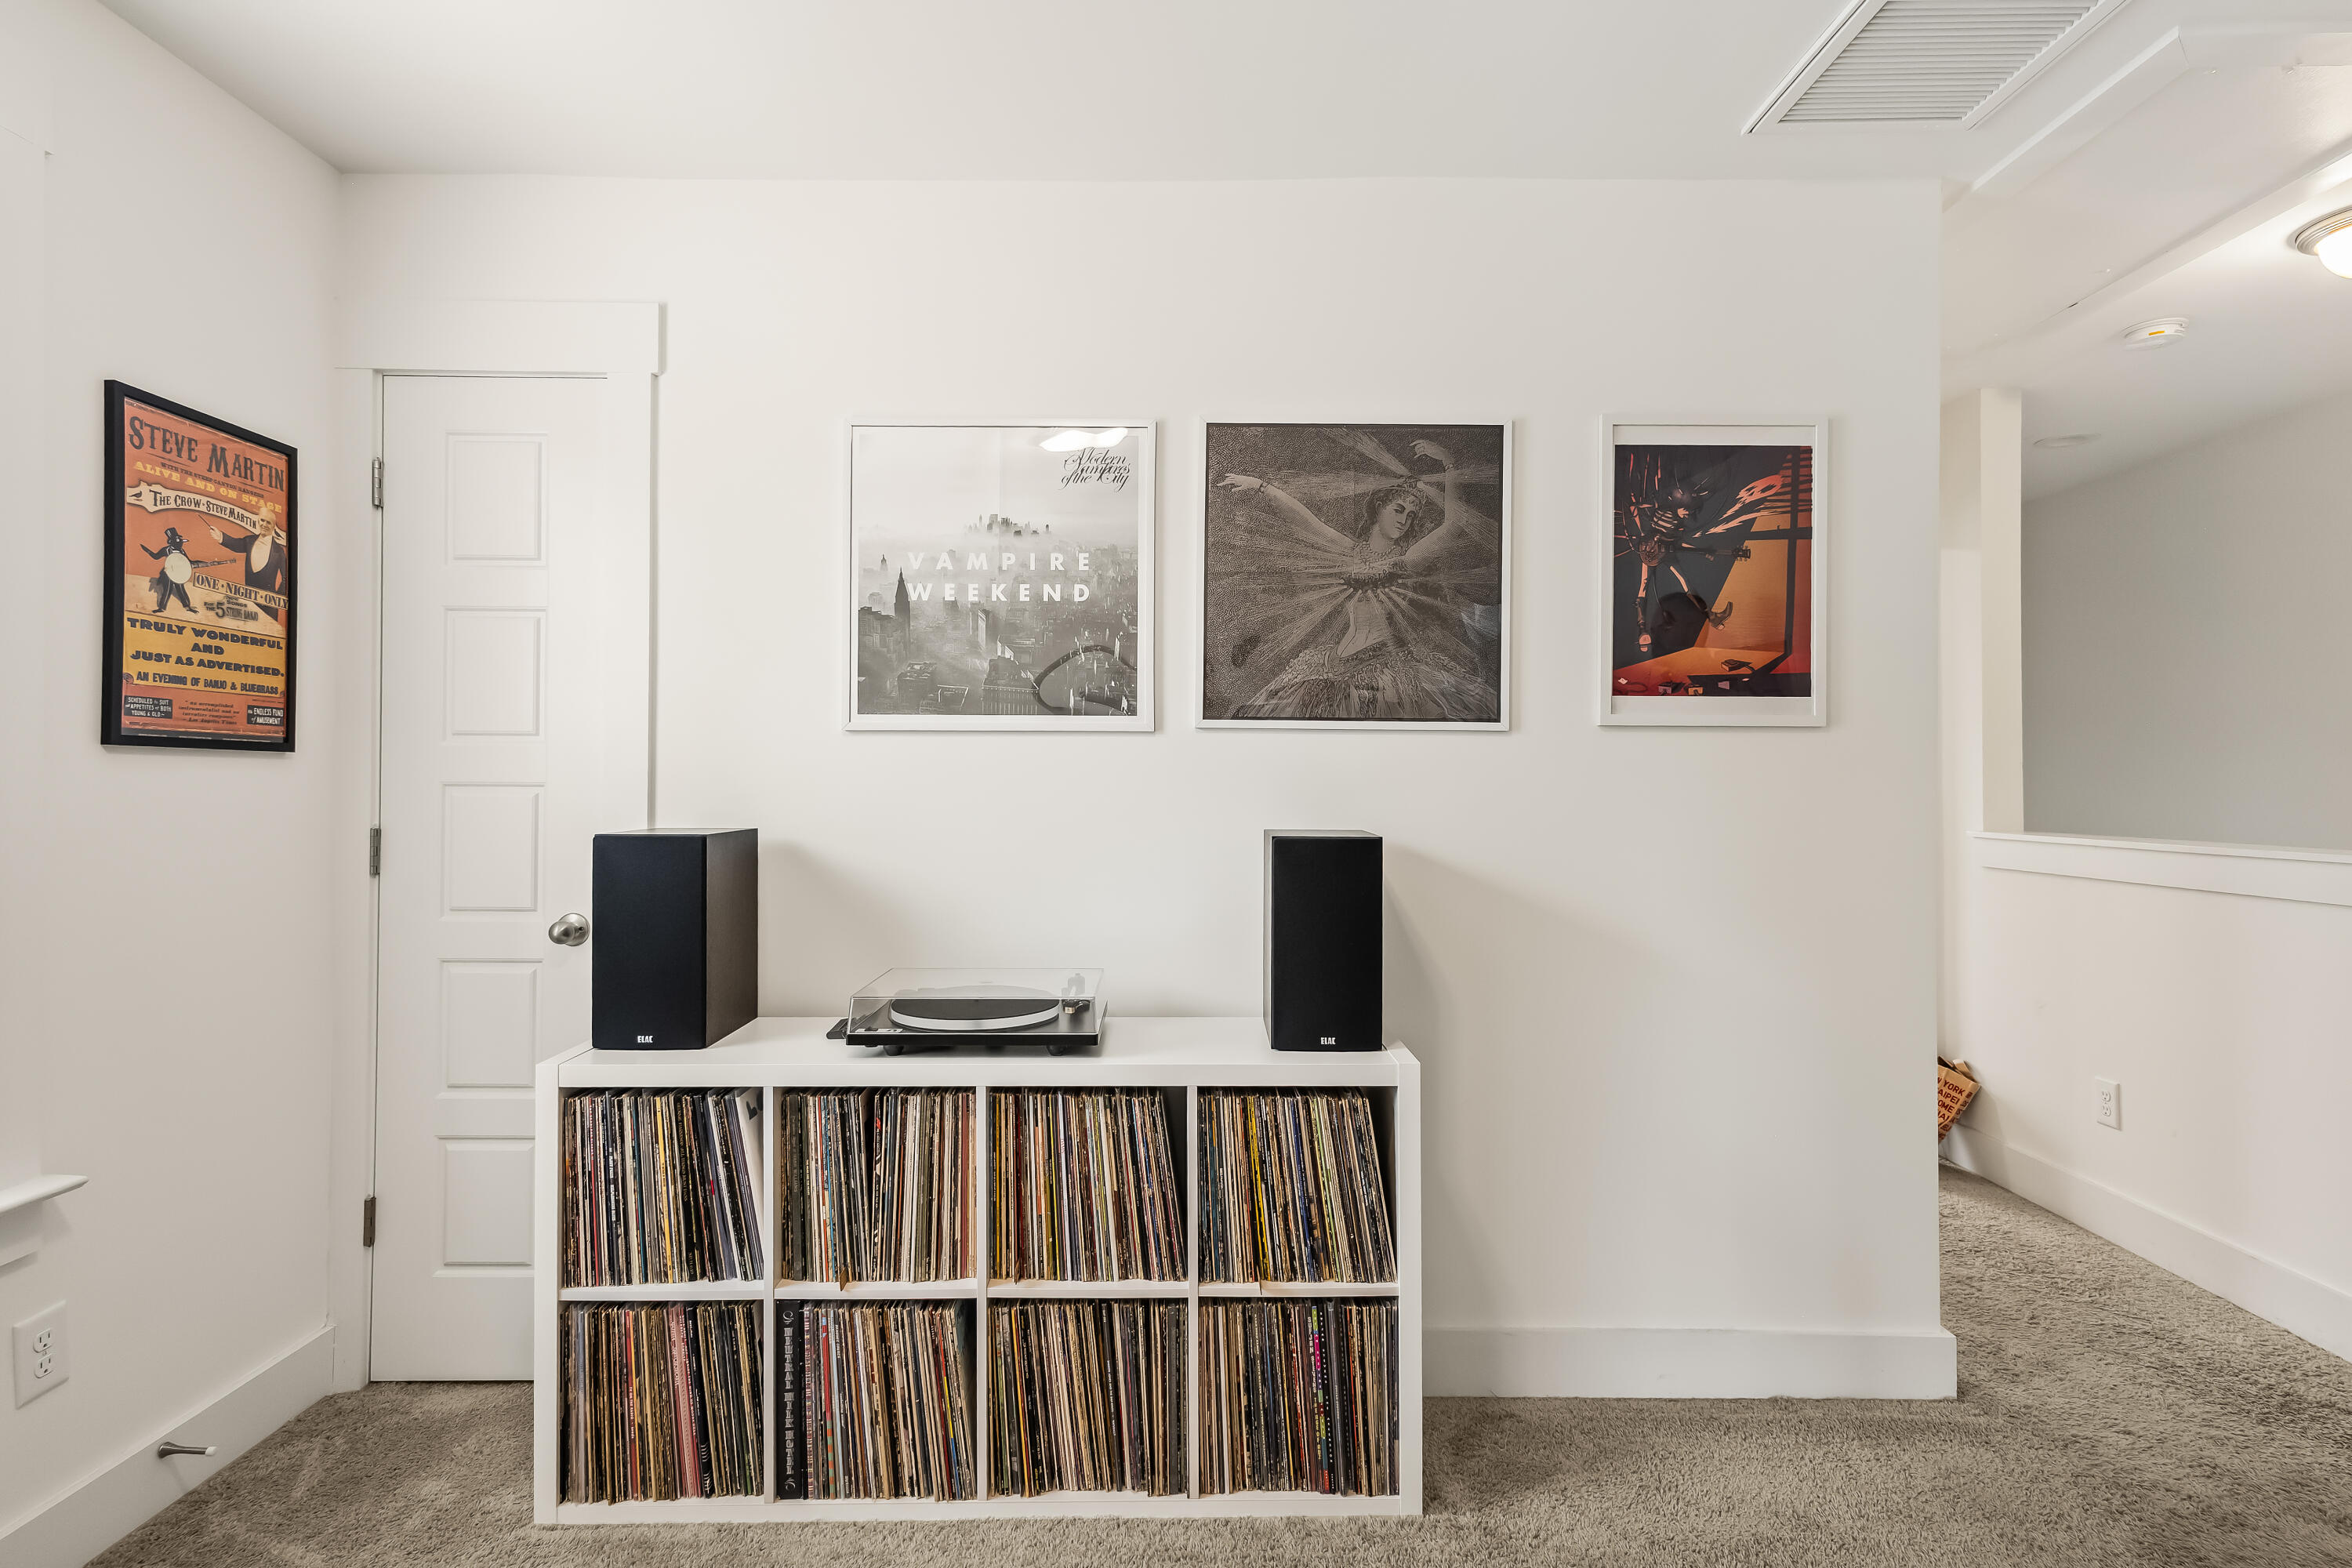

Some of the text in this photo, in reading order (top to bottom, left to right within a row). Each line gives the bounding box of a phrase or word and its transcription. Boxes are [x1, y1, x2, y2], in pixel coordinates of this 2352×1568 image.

[129, 416, 285, 492] STEVE MARTIN
[1066, 447, 1127, 466] Modern
[133, 461, 282, 514] ALIVE AND ON STAGE
[149, 489, 257, 530] THE CROW STEVE MARTIN
[907, 552, 1090, 571] VAMPIRE
[196, 574, 289, 608] ONE NIGHT ONLY
[906, 583, 1091, 602] WEEKEND
[216, 602, 225, 618] 5
[127, 618, 283, 650] TRULY WONDERFUL
[191, 643, 224, 655] AND
[130, 650, 285, 677] JUST AS ADVERTISED.
[136, 671, 149, 682] AN
[152, 673, 187, 686] EVENING
[191, 677, 201, 687] OF
[204, 679, 227, 690] BANJO
[241, 683, 279, 695] BLUEGRASS
[637, 1035, 653, 1044] ELAC
[1938, 1088, 1961, 1105] AIPEI
[1943, 1079, 1966, 1096] YORK
[1938, 1100, 1955, 1113] OME
[784, 1327, 793, 1389] NEUTRAL
[784, 1392, 794, 1428] MILK
[1316, 1432, 1320, 1443] OF
[785, 1430, 794, 1475] HOTEL
